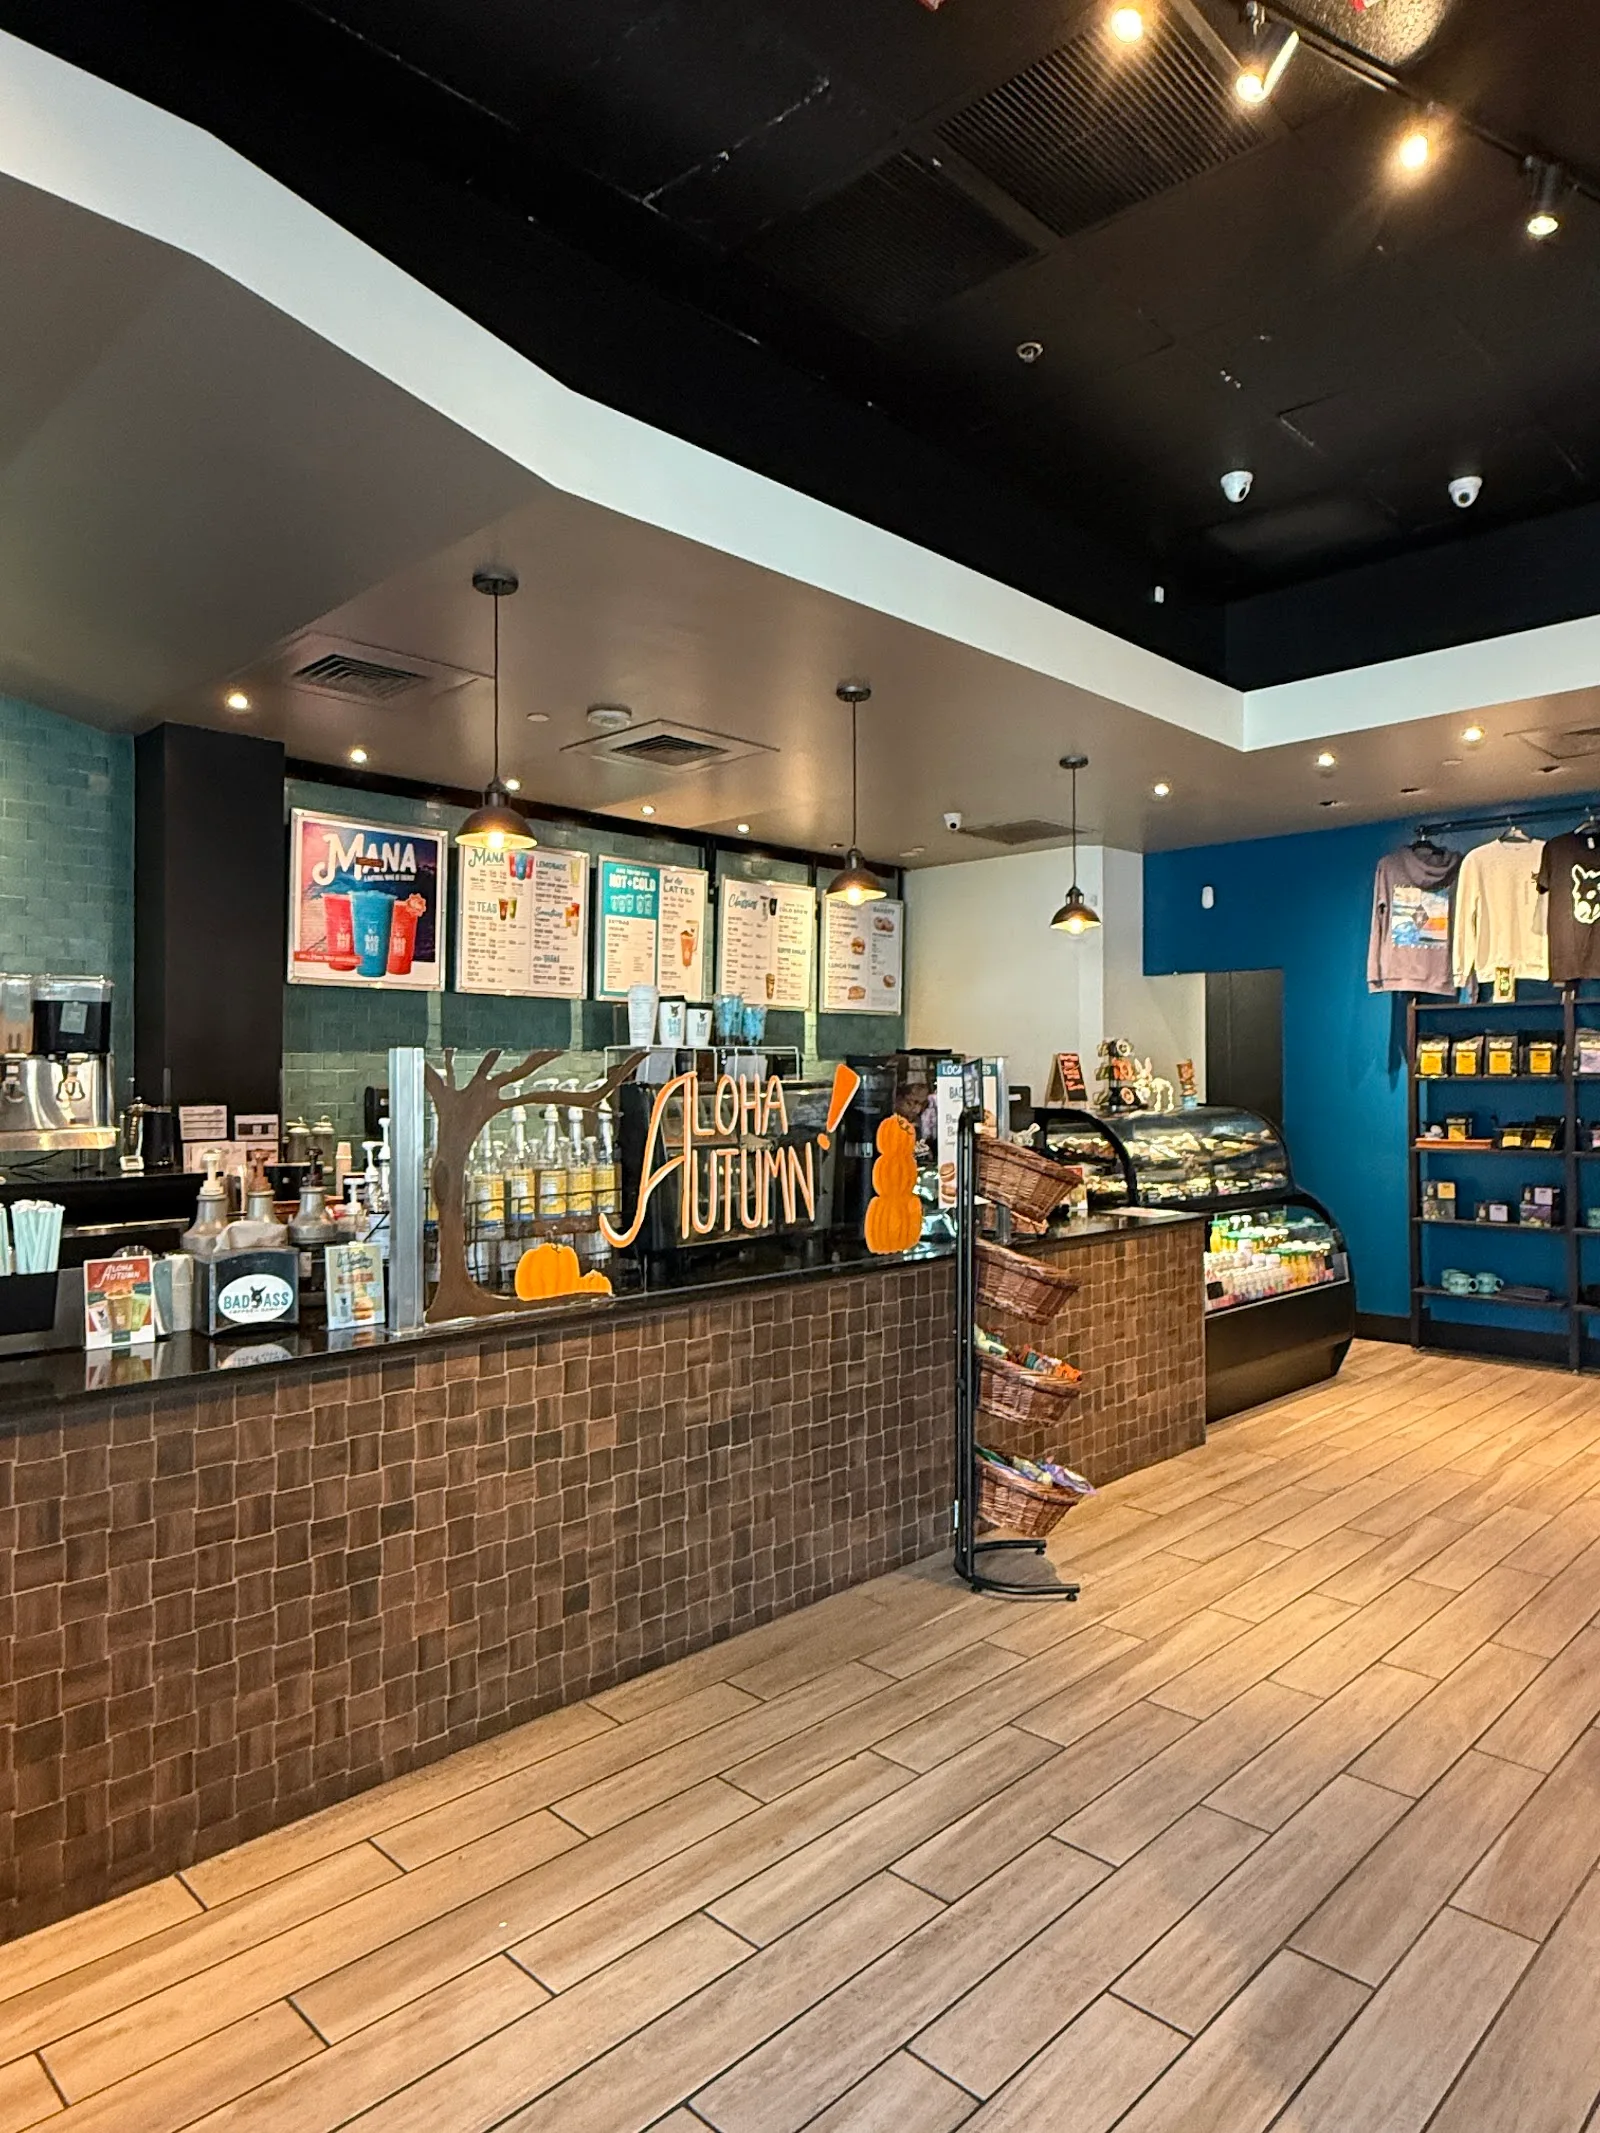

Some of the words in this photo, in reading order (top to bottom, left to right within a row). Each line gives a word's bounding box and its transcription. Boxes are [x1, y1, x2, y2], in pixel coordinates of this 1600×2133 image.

[312, 833, 417, 886] MANA
[468, 848, 505, 867] MANA
[609, 874, 627, 889] HOT
[632, 876, 656, 892] COLD
[663, 884, 695, 896] LATTES
[477, 901, 498, 914] TEAS
[942, 1065, 963, 1075] LOCA
[650, 1070, 789, 1136] ALOHA
[223, 1294, 250, 1310] BAD
[263, 1291, 289, 1307] ASS
